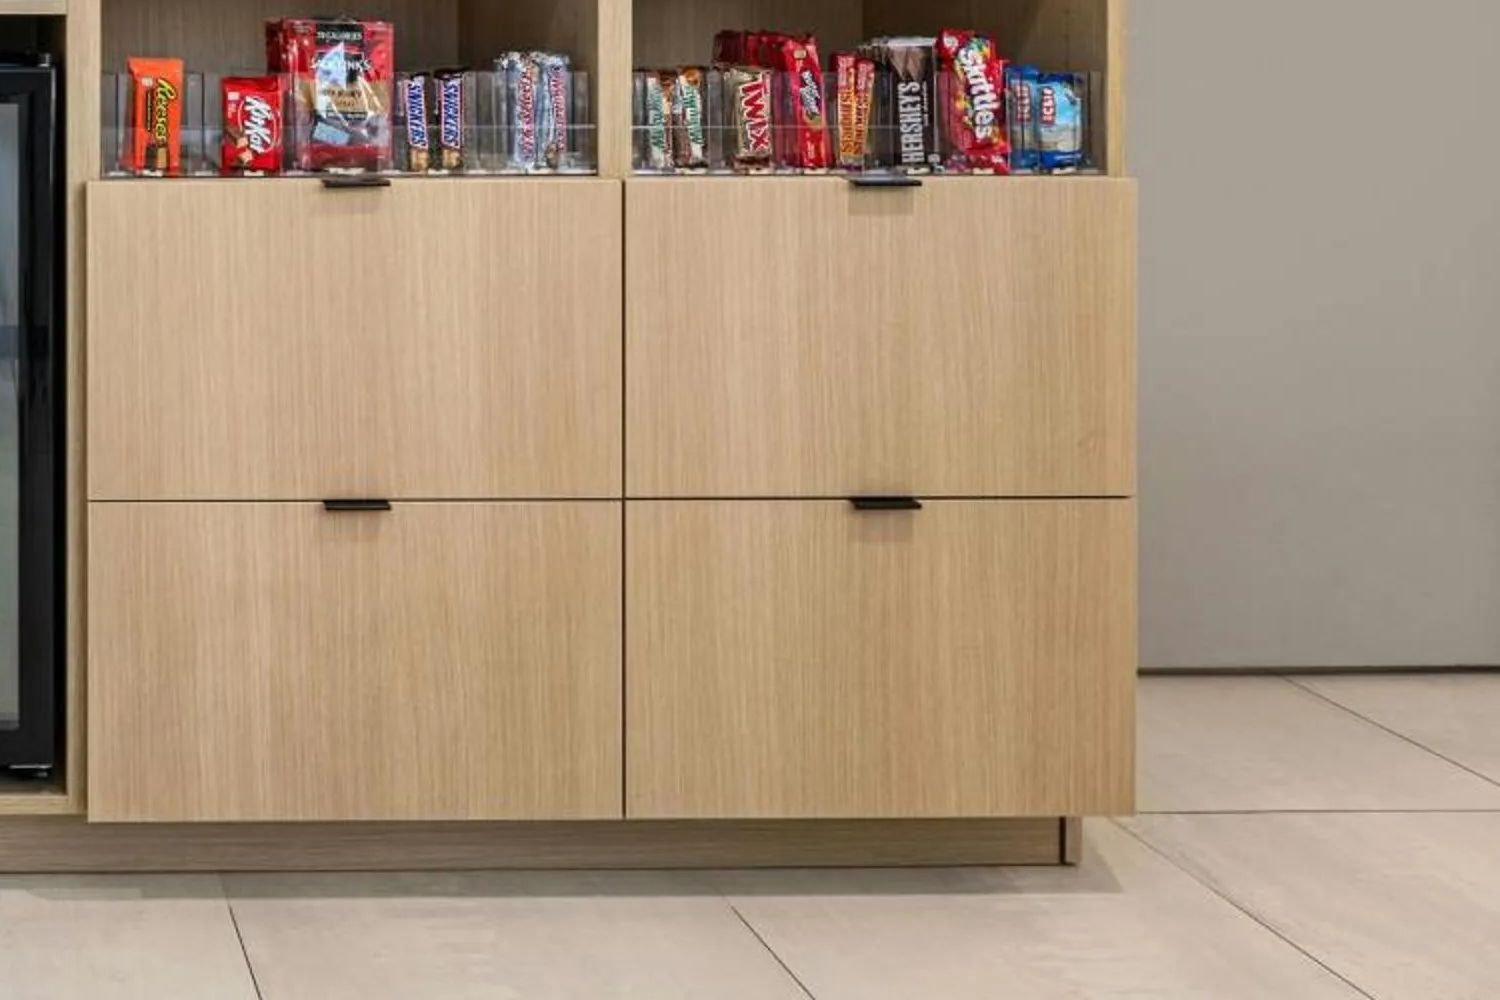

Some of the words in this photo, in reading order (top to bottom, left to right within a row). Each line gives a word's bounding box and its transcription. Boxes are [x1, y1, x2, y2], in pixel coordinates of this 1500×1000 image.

[407, 82, 428, 147] SNICKERS
[443, 82, 460, 147] SNICKERS
[899, 81, 926, 163] HERSHEY'S
